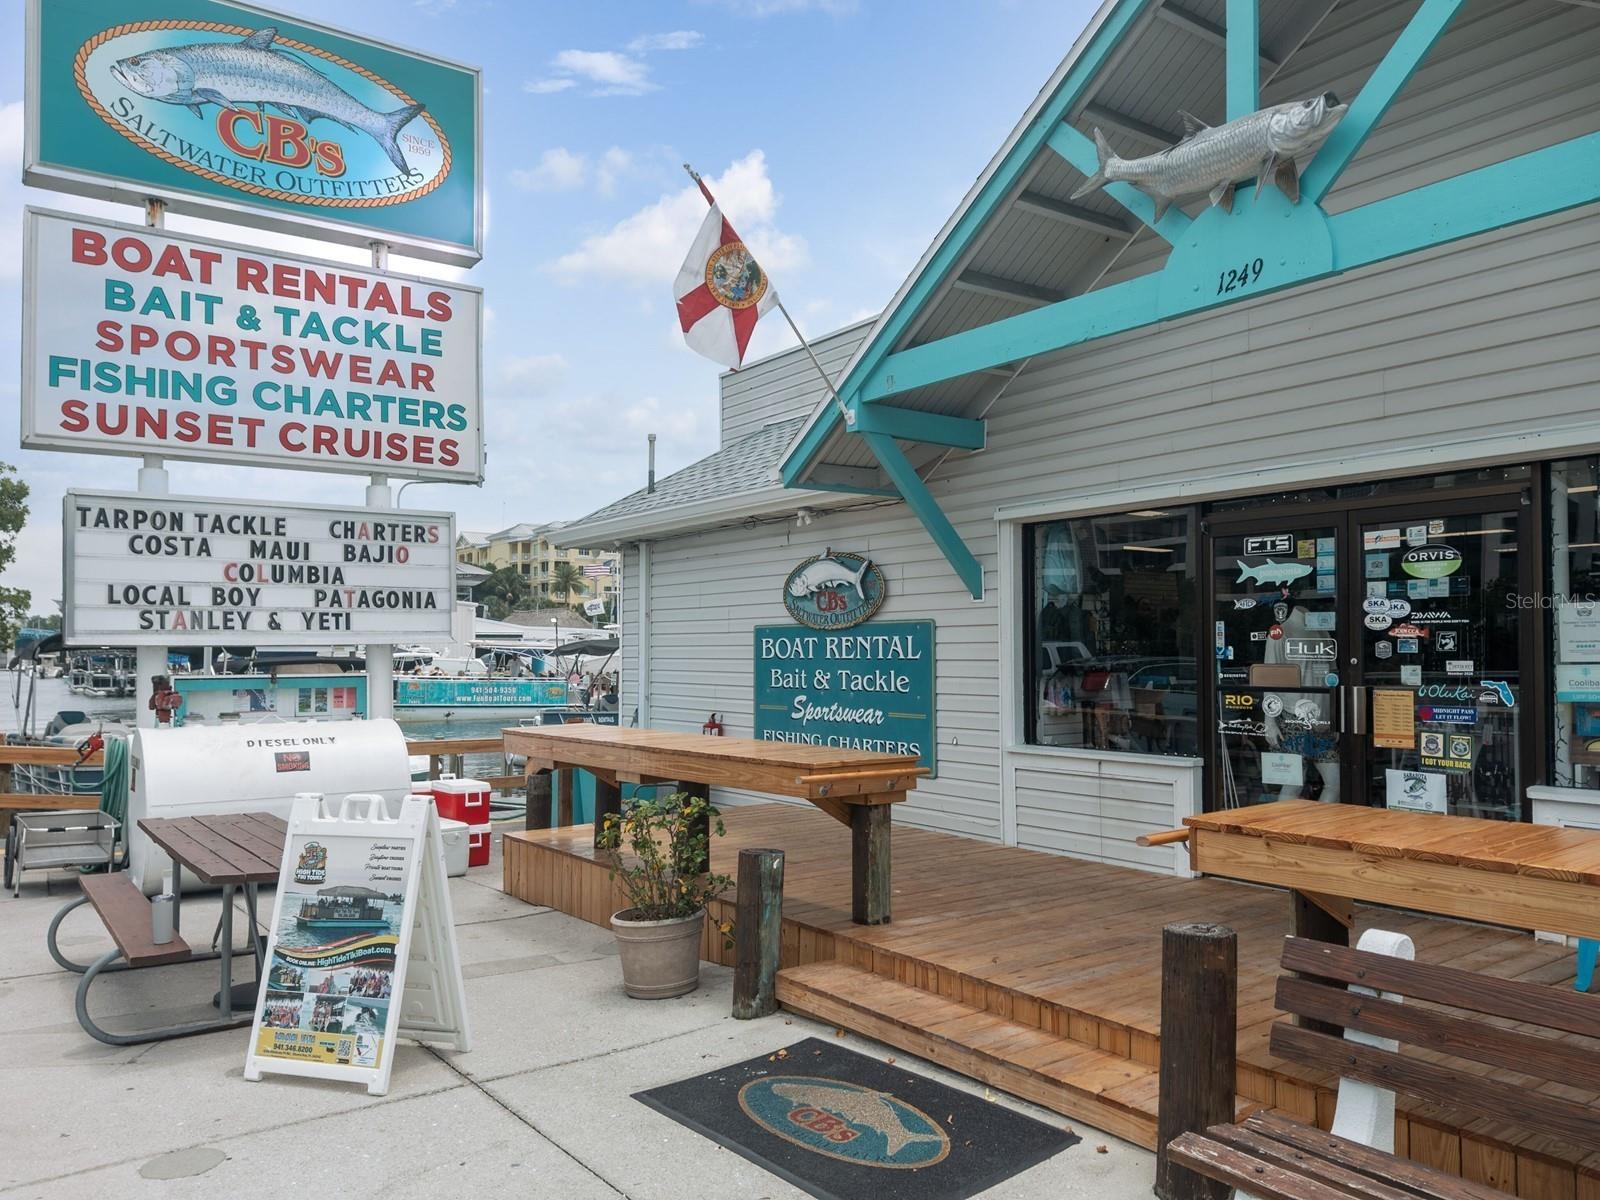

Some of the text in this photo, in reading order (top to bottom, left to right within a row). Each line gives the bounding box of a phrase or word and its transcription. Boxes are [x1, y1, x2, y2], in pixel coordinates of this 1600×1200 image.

[110, 97, 425, 199] SALTWATER OUTFITTERS
[216, 107, 346, 177] CB's
[402, 133, 435, 149] SINCE
[407, 144, 431, 157] 1959
[72, 228, 452, 322] BOAT RENTALS
[1216, 258, 1264, 296] 1249
[105, 279, 442, 357] BAIT & TACKLE
[96, 320, 435, 392] SPORTSWEAR
[49, 354, 467, 431] FISHING CHARTERS
[60, 400, 460, 466] SUNSET CRUISES
[76, 507, 440, 544] TARPON TACKLE CHARTERS
[129, 534, 409, 564] COSTA MAUI BAJIO
[1248, 536, 1289, 551] FTS
[1408, 550, 1454, 562] ORVIS
[223, 562, 345, 585] COLUMBIA
[107, 584, 436, 609] LOCAL BOY PATAGONIA
[140, 610, 351, 631] STANLEY & YETI
[761, 636, 922, 660] BOAT RENTAL
[770, 668, 910, 693] Bait & Tackle
[790, 696, 885, 726] Sportswear
[1225, 695, 1253, 705] RIO
[246, 736, 336, 748] DIESEL ONLY
[763, 730, 921, 756] FISHING CHARTERS
[1403, 772, 1427, 780] SARASOTA
[1425, 758, 1436, 766] GOT
[1438, 759, 1454, 767] YOUR
[1454, 761, 1471, 769] BACK
[317, 947, 392, 966] HighTideTikiBoat.com
[273, 1044, 313, 1053] 941.346.8200
